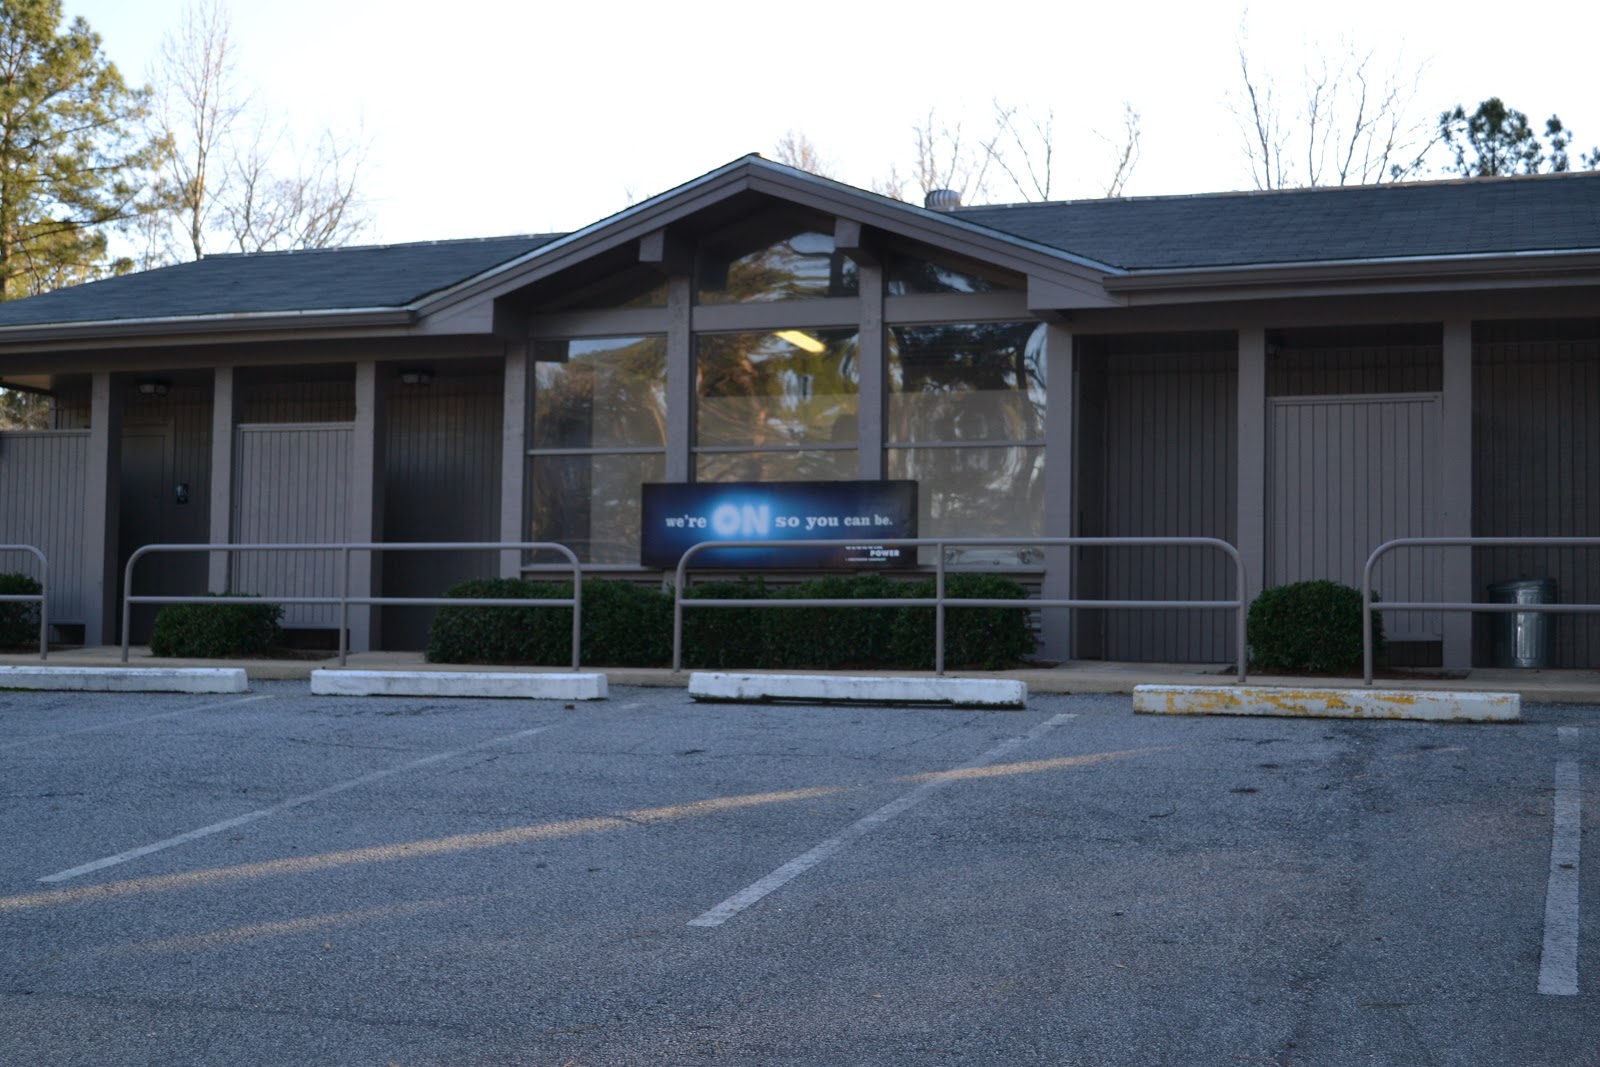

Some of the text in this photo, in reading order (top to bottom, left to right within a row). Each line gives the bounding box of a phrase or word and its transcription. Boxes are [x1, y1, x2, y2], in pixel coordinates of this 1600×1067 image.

[665, 504, 893, 535] we're ON so you can be.
